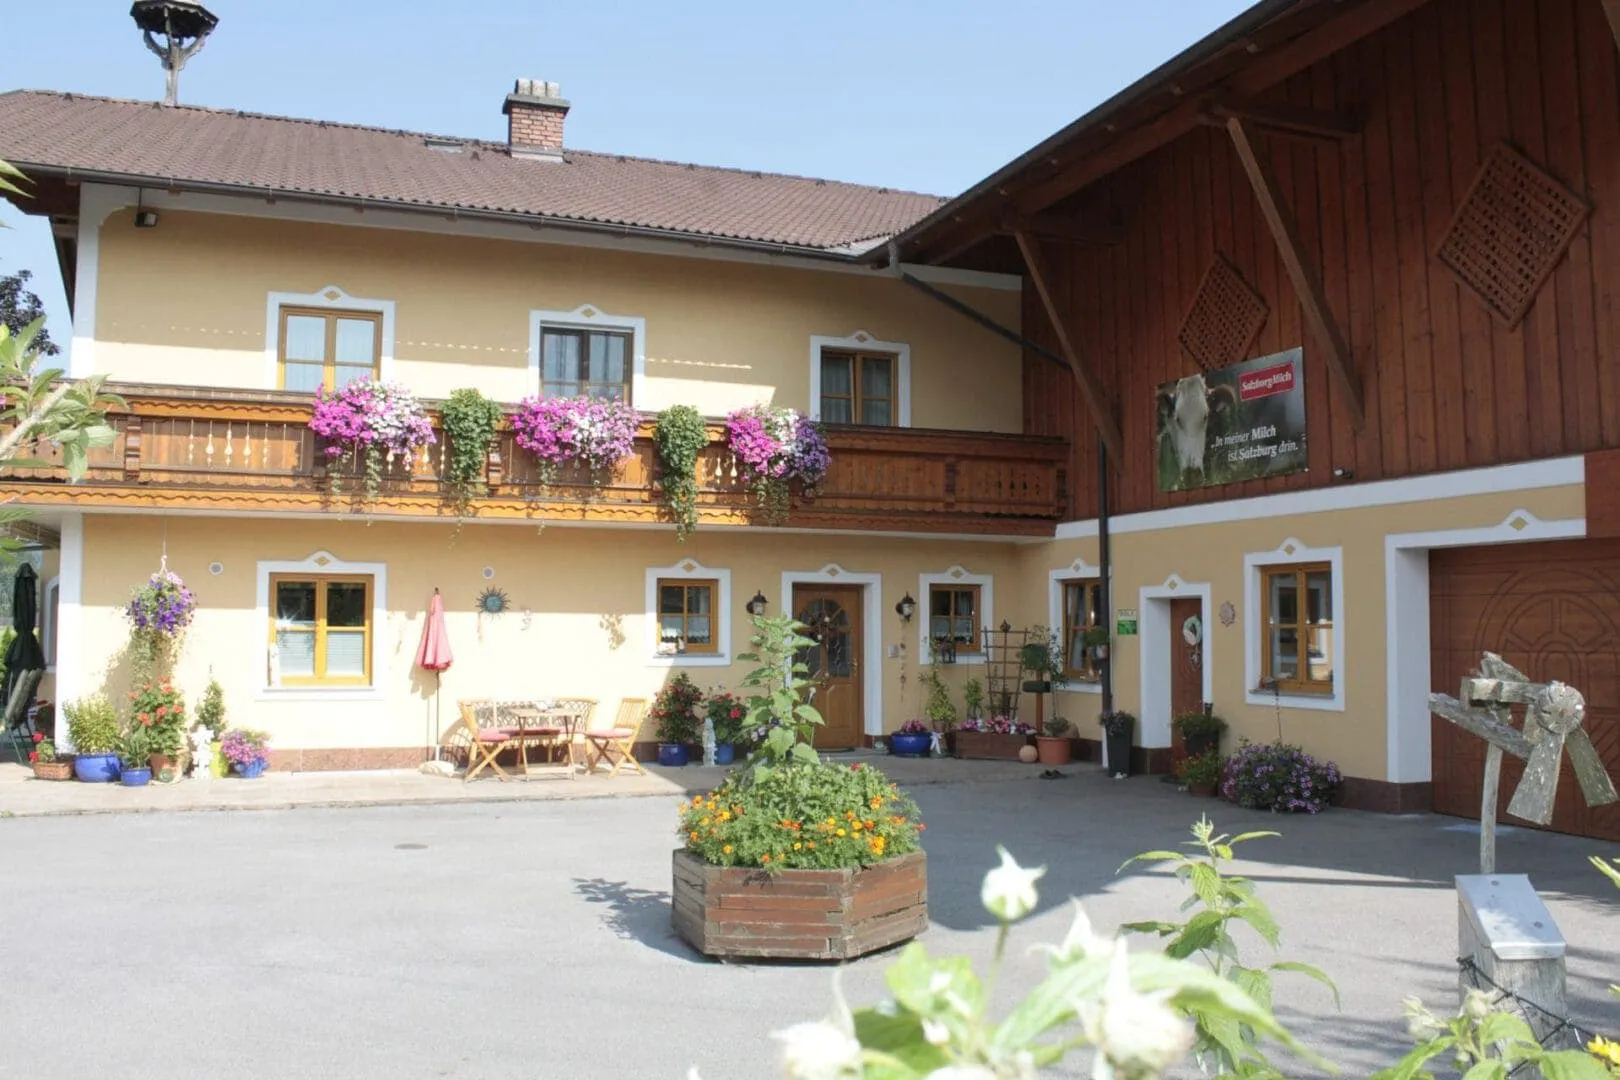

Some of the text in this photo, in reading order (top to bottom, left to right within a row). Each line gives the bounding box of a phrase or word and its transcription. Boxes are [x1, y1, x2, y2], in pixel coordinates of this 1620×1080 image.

[1224, 432, 1250, 445] meiner
[1251, 425, 1276, 441] Milch
[1228, 440, 1298, 461] ist Salzburg drin.
